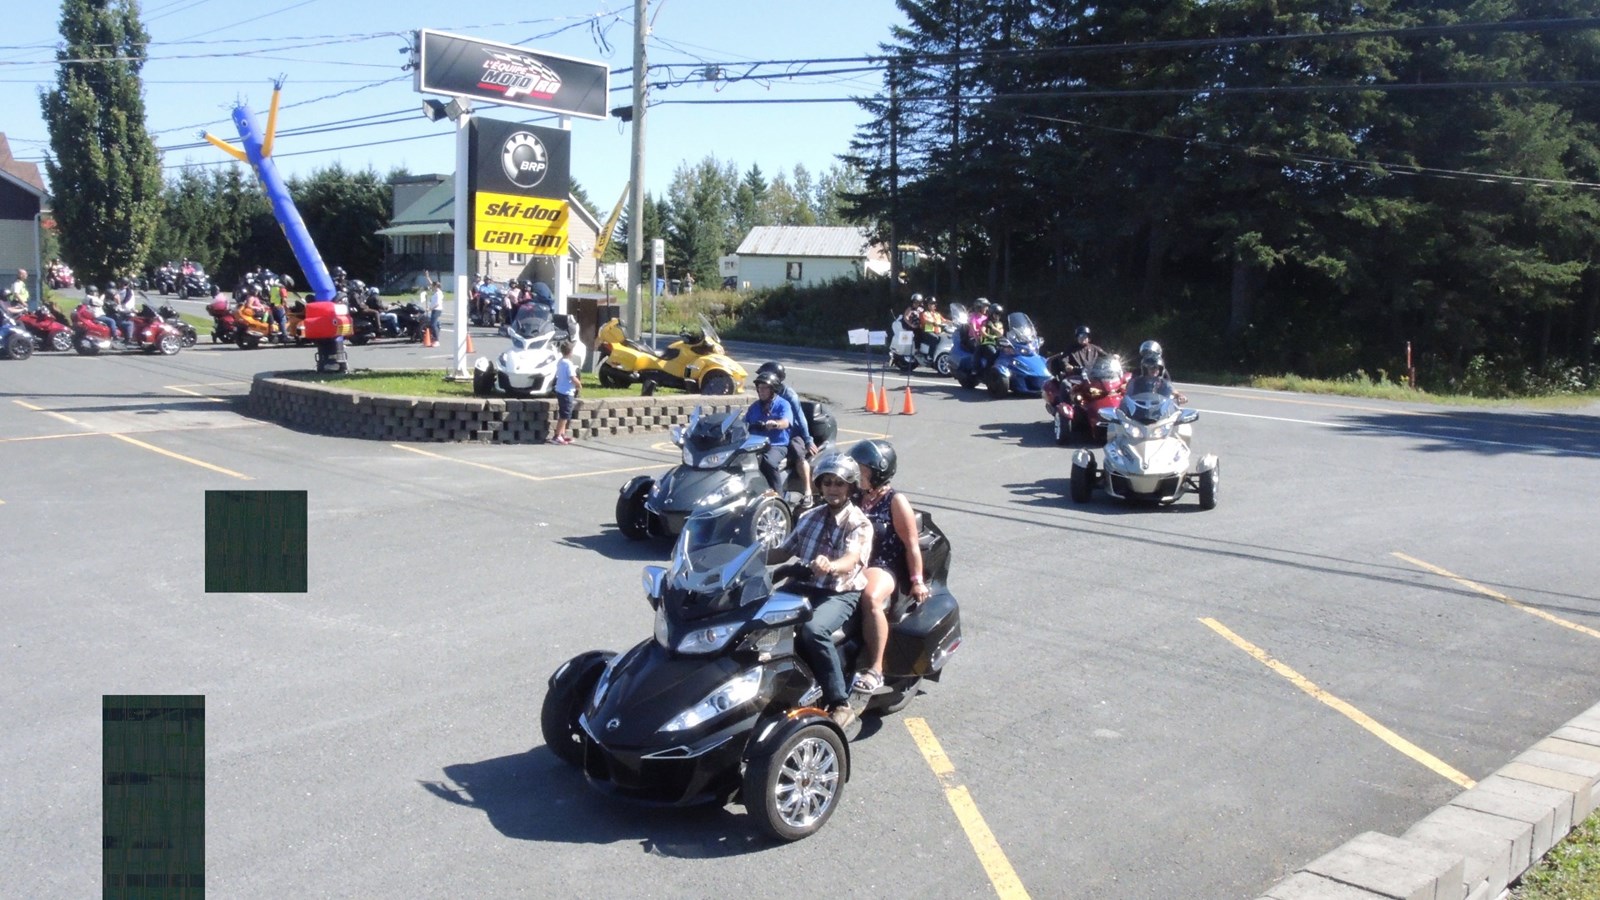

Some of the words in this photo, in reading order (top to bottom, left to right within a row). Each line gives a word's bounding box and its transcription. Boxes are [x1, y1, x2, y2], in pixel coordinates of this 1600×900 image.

[482, 60, 528, 75] L'ÉQUIPE
[480, 69, 533, 89] MOTO
[520, 161, 545, 172] BRP
[484, 201, 561, 222] ski-doo
[483, 230, 562, 248] can-am
